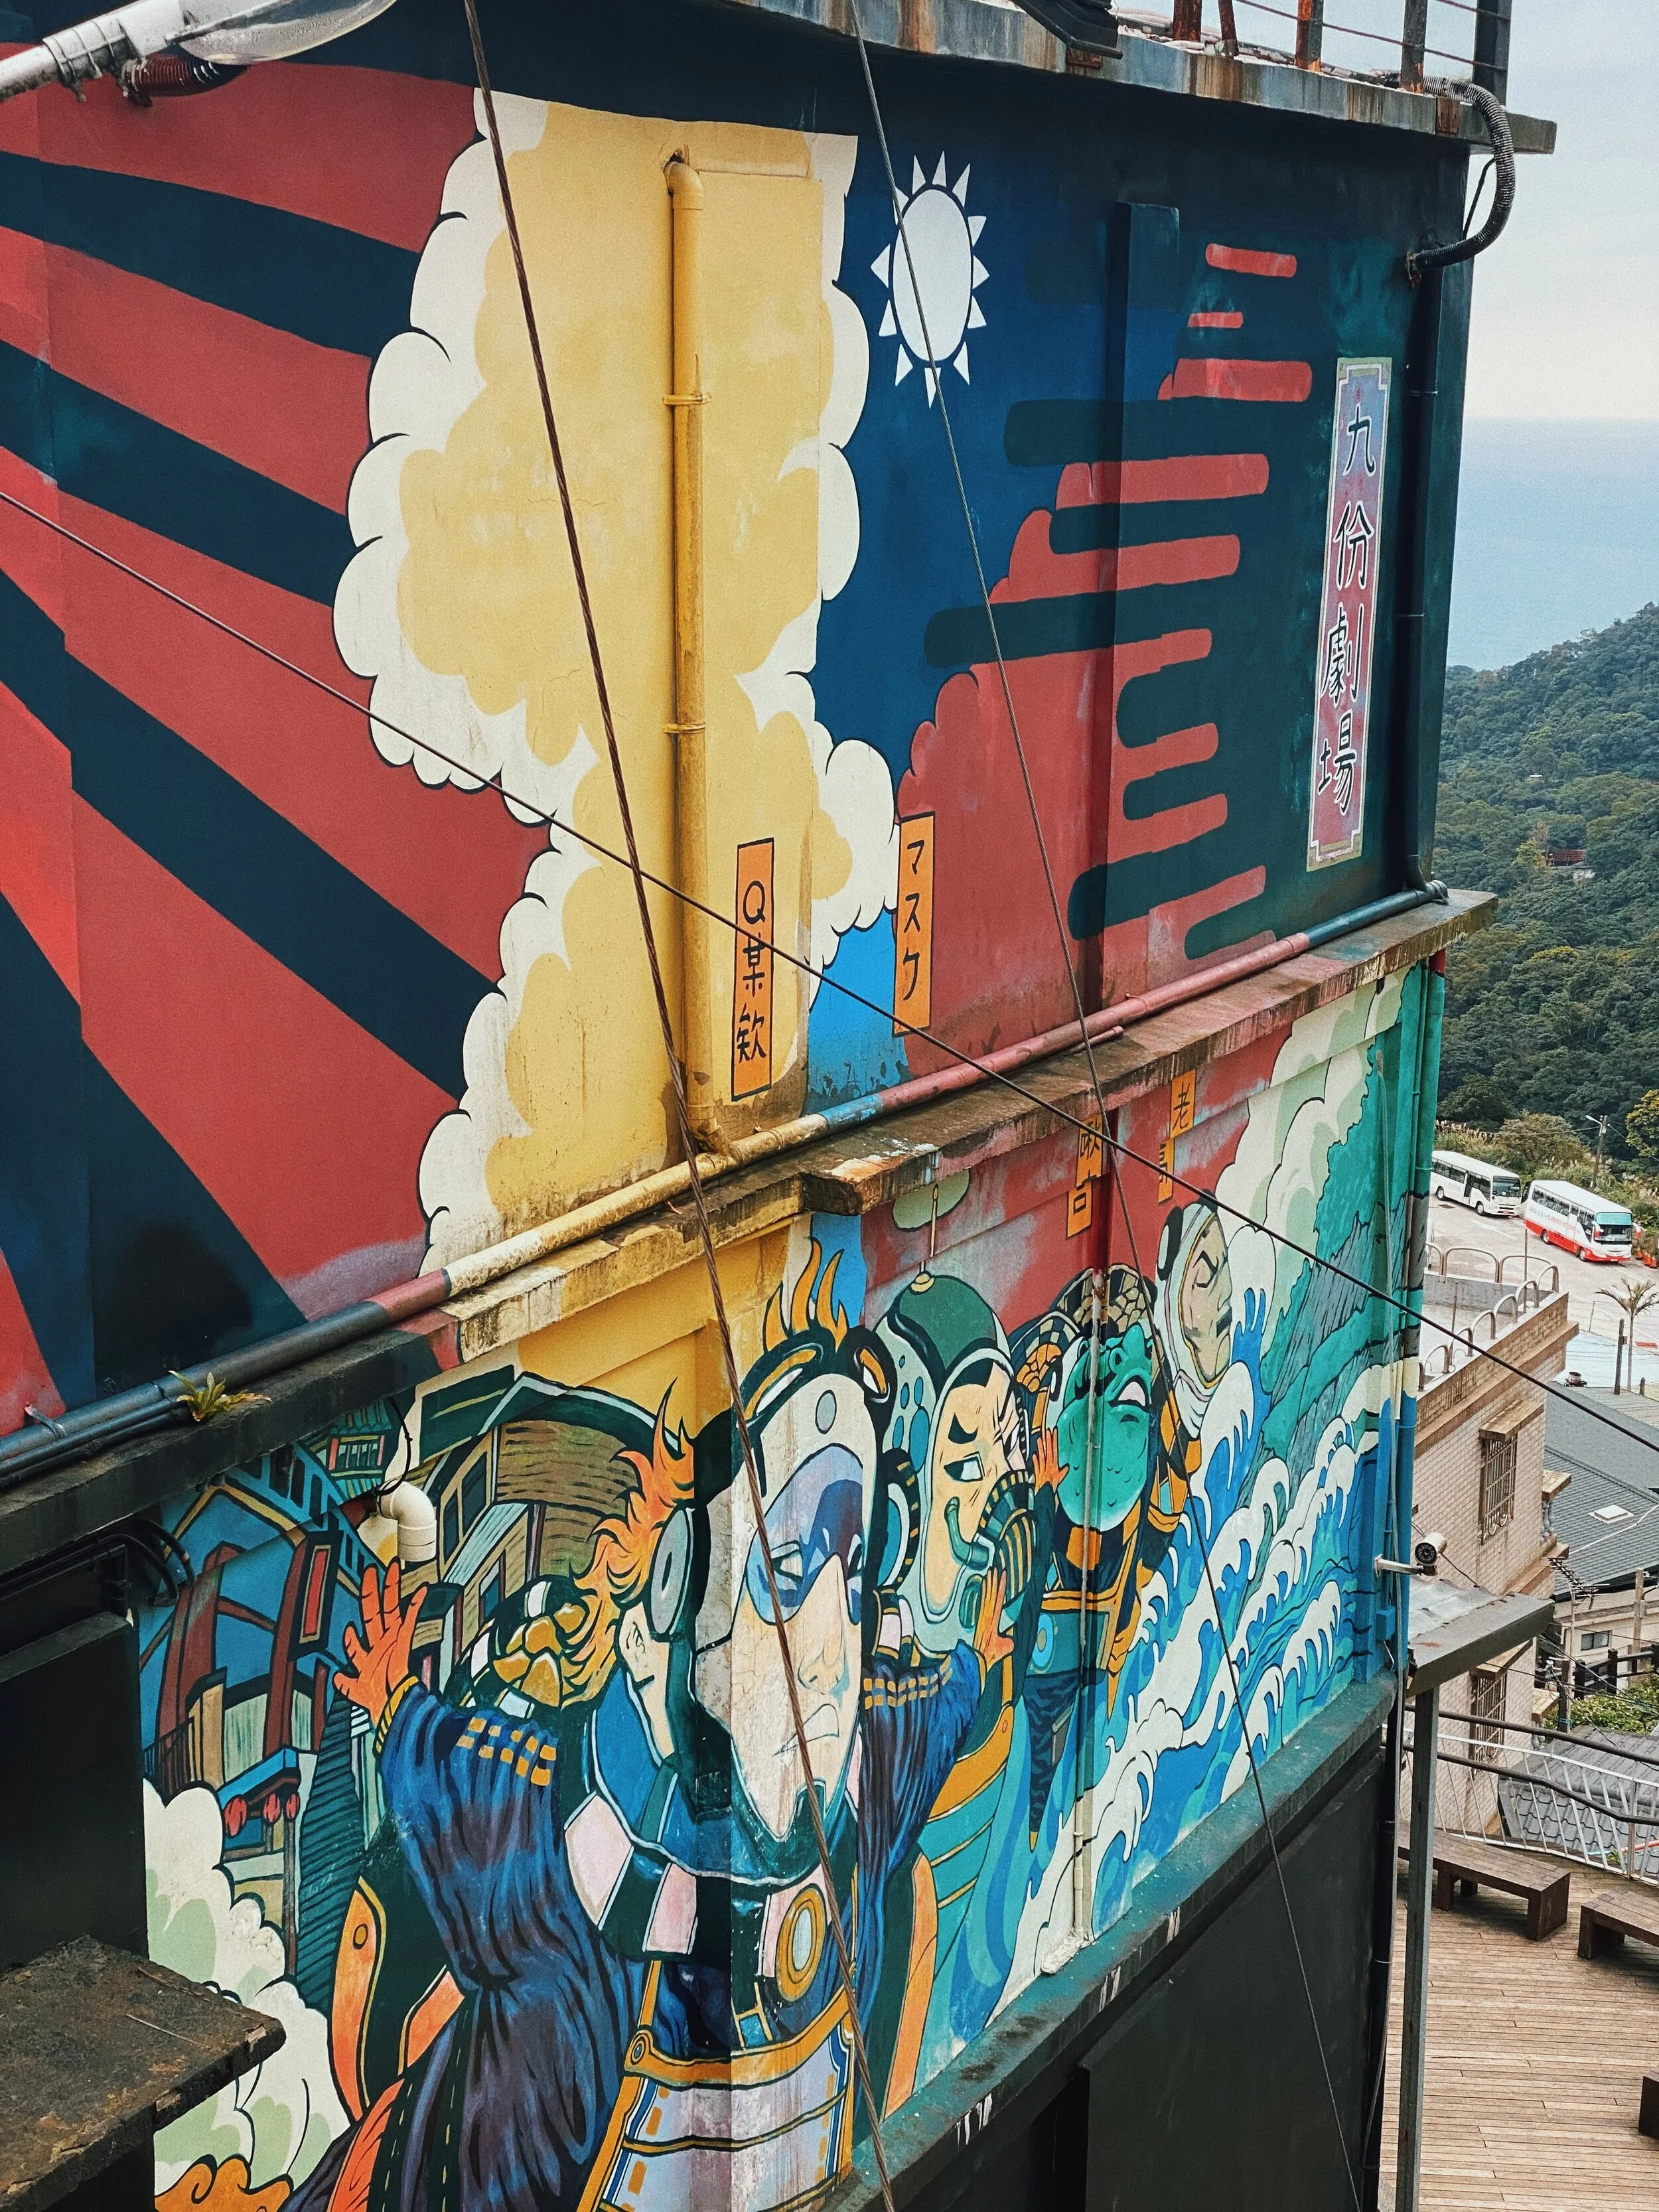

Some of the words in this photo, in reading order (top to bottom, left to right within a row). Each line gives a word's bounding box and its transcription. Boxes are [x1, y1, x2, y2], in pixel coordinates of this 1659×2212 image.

[1317, 404, 1376, 816] 九份劇場
[903, 839, 925, 1001] マスク
